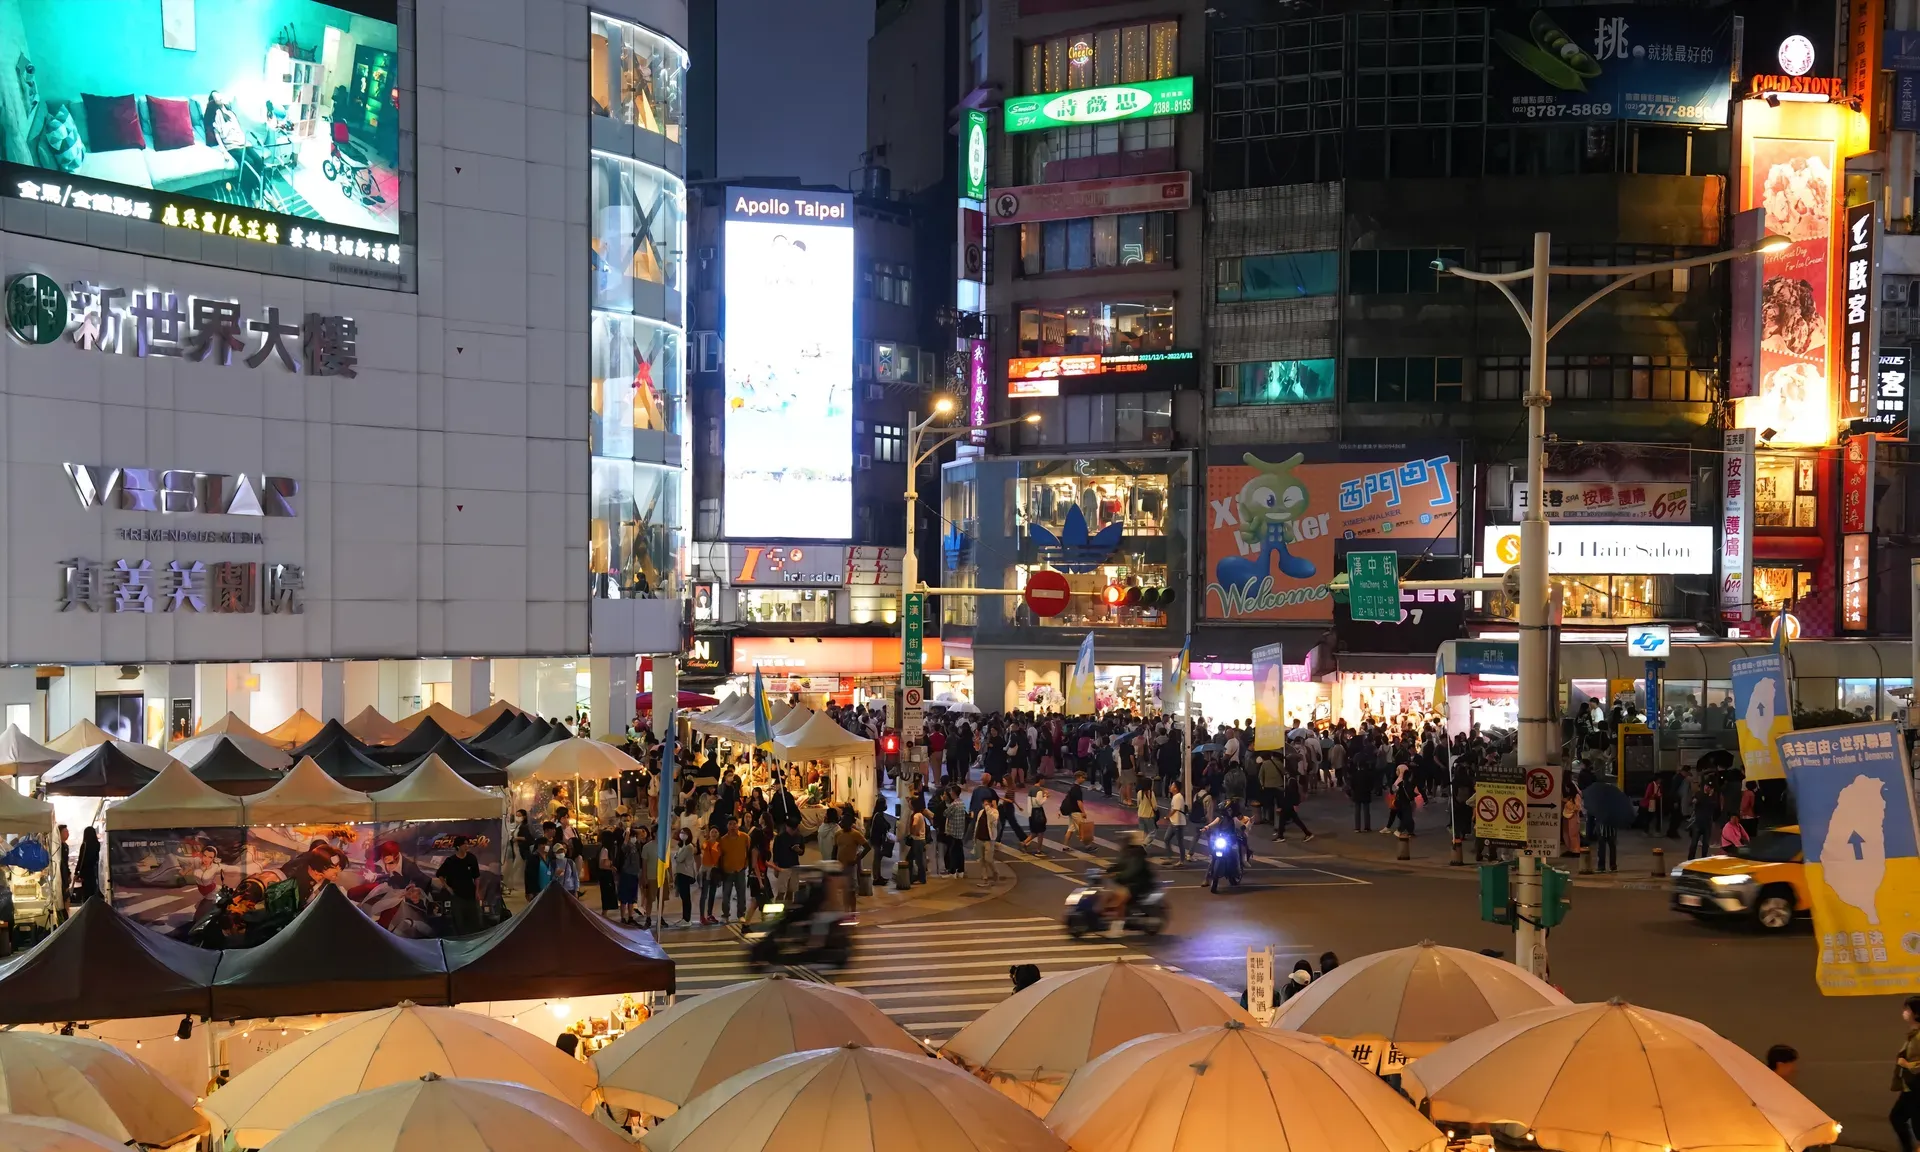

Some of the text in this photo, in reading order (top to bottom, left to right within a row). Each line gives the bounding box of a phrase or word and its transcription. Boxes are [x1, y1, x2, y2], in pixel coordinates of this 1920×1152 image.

[1594, 17, 1629, 60] 挑
[1648, 43, 1713, 64] 就挑最好的
[1752, 74, 1843, 99] COLD STONE
[1016, 115, 1037, 127] SPA
[735, 197, 845, 220] Apollo Taipei
[68, 279, 358, 379] 新世界大樓
[1876, 370, 1906, 397] 客
[1882, 414, 1897, 425] 4F
[62, 461, 297, 518] WESTAR
[1339, 454, 1454, 512] 西門町
[1726, 457, 1742, 499] 按摩
[120, 528, 216, 543] TREMENDOUS
[1724, 515, 1741, 558] 護膚
[1580, 541, 1631, 558] Hair
[1635, 541, 1692, 558] Salon
[1353, 556, 1393, 576] 漢中街
[56, 557, 305, 615] 真善美劇院
[1206, 575, 1330, 619] Welcome
[909, 604, 919, 649] 漢中街
[1832, 753, 1857, 765] Freedom
[1864, 751, 1895, 762] Democracy
